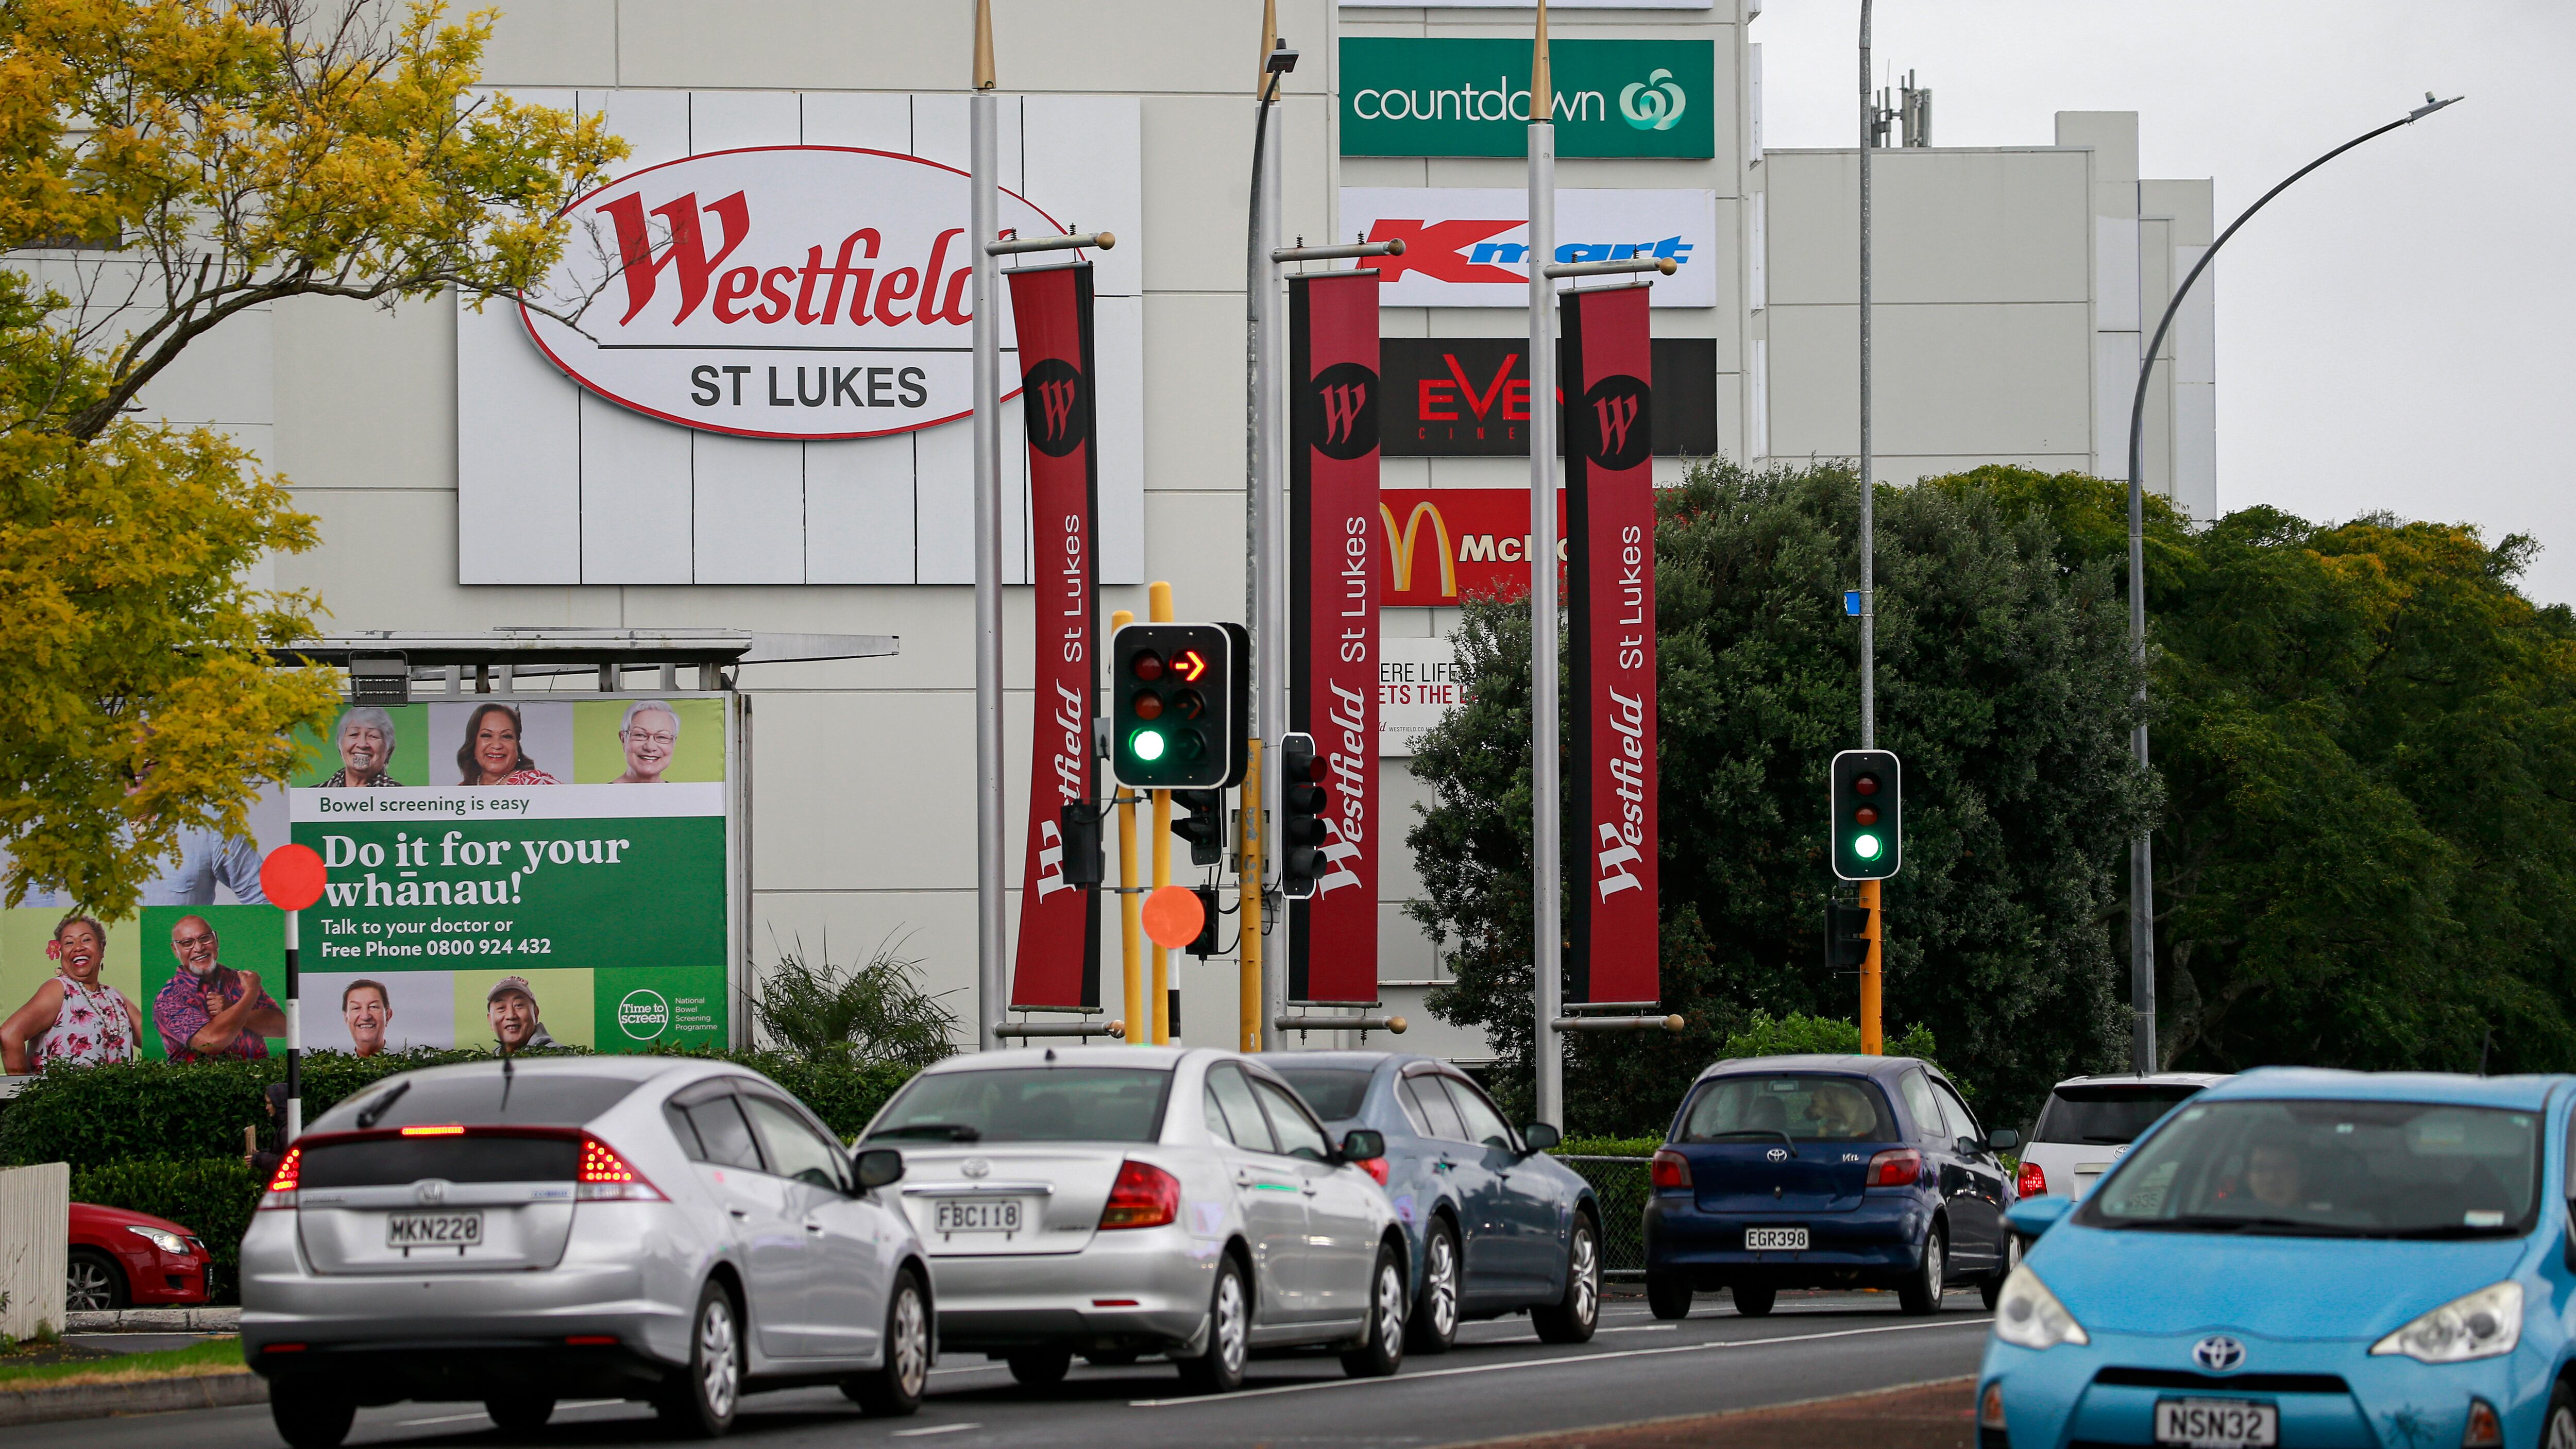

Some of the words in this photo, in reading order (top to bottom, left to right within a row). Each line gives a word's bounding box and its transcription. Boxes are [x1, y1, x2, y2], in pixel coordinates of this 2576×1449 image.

[1353, 76, 1605, 121] countdown
[1357, 219, 1693, 283] Kmart
[691, 365, 750, 407] ST
[769, 366, 927, 407] LUKES
[1419, 428, 1514, 439] CINE
[1063, 515, 1081, 616] Lukes
[1341, 517, 1366, 617] Lukes
[1619, 525, 1642, 624] Lukes
[1064, 627, 1082, 662] St
[1341, 627, 1366, 662] St
[1619, 634, 1643, 669] St
[1381, 663, 1414, 681] ERE
[1379, 685, 1410, 704] ETS
[1417, 685, 1452, 704] THE
[320, 796, 374, 812] Bowel
[380, 796, 466, 816] screening
[471, 795, 484, 810] is
[490, 799, 530, 814] easy
[1037, 678, 1081, 904] Wtfield
[1317, 678, 1364, 901] Westfield
[1598, 685, 1643, 905] Westfield
[322, 836, 384, 867] Do
[395, 832, 429, 866] it
[440, 831, 511, 866] for
[520, 839, 630, 874] your
[324, 871, 521, 907] whānau!
[321, 918, 357, 934] Talk
[361, 922, 381, 934] to
[385, 922, 427, 939] your
[430, 917, 490, 933] doctor
[494, 920, 513, 932] or
[322, 942, 361, 957] Free
[366, 941, 422, 957] Phone
[427, 940, 474, 956] 0800
[479, 939, 513, 954] 924
[517, 938, 551, 954] 432
[621, 1014, 666, 1024] screen
[623, 1004, 651, 1013] Time
[654, 1003, 664, 1013] to
[939, 1206, 1016, 1226] FBC118
[1748, 1232, 1806, 1247] EGR398
[2170, 1409, 2263, 1440] NSN32
